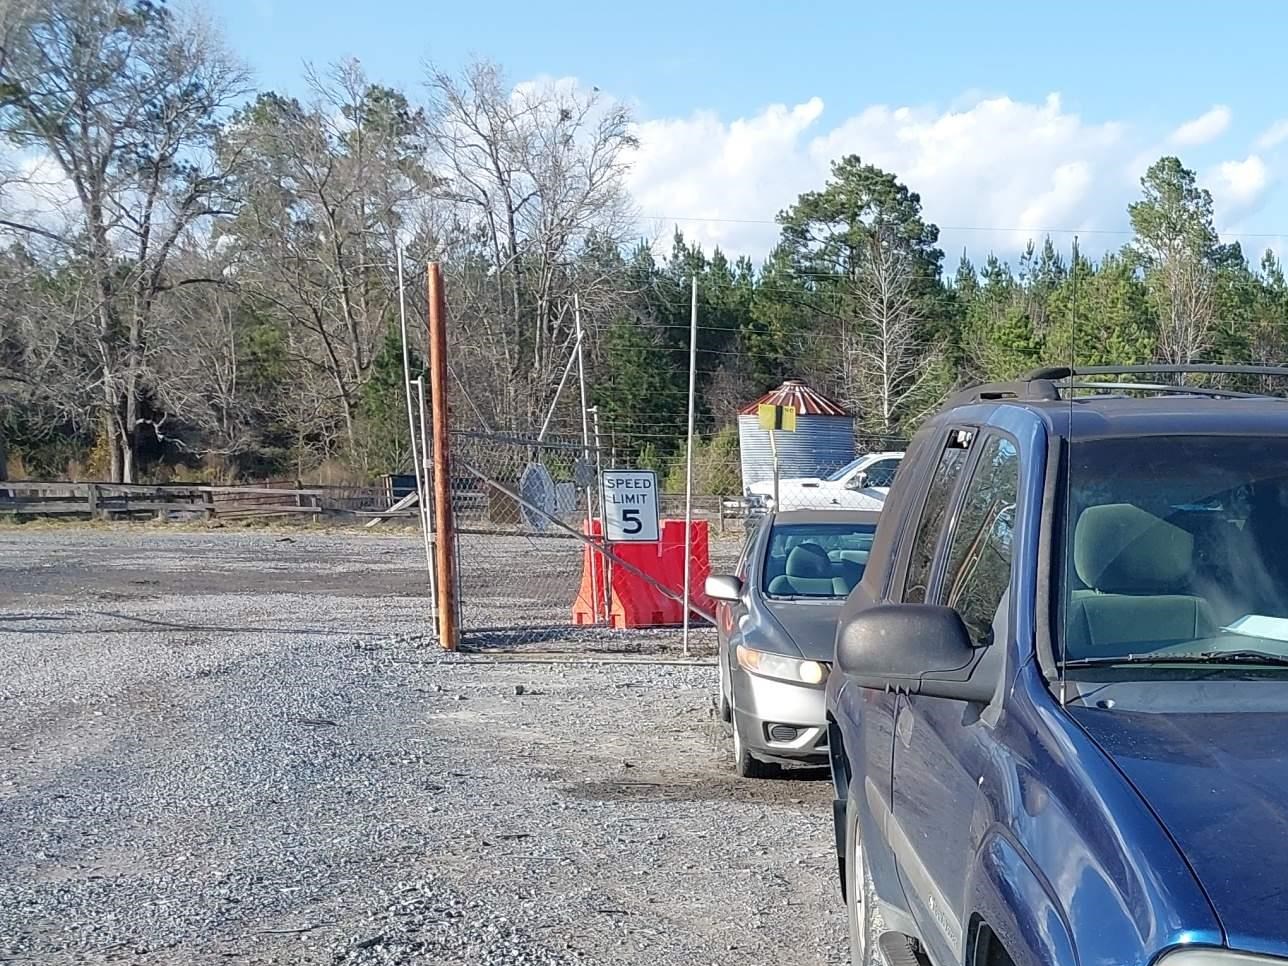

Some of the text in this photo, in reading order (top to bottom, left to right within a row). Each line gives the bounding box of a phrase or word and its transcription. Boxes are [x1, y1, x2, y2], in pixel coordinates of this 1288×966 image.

[607, 479, 652, 489] SPEED
[612, 493, 648, 505] LIMIT
[622, 509, 643, 534] 5
